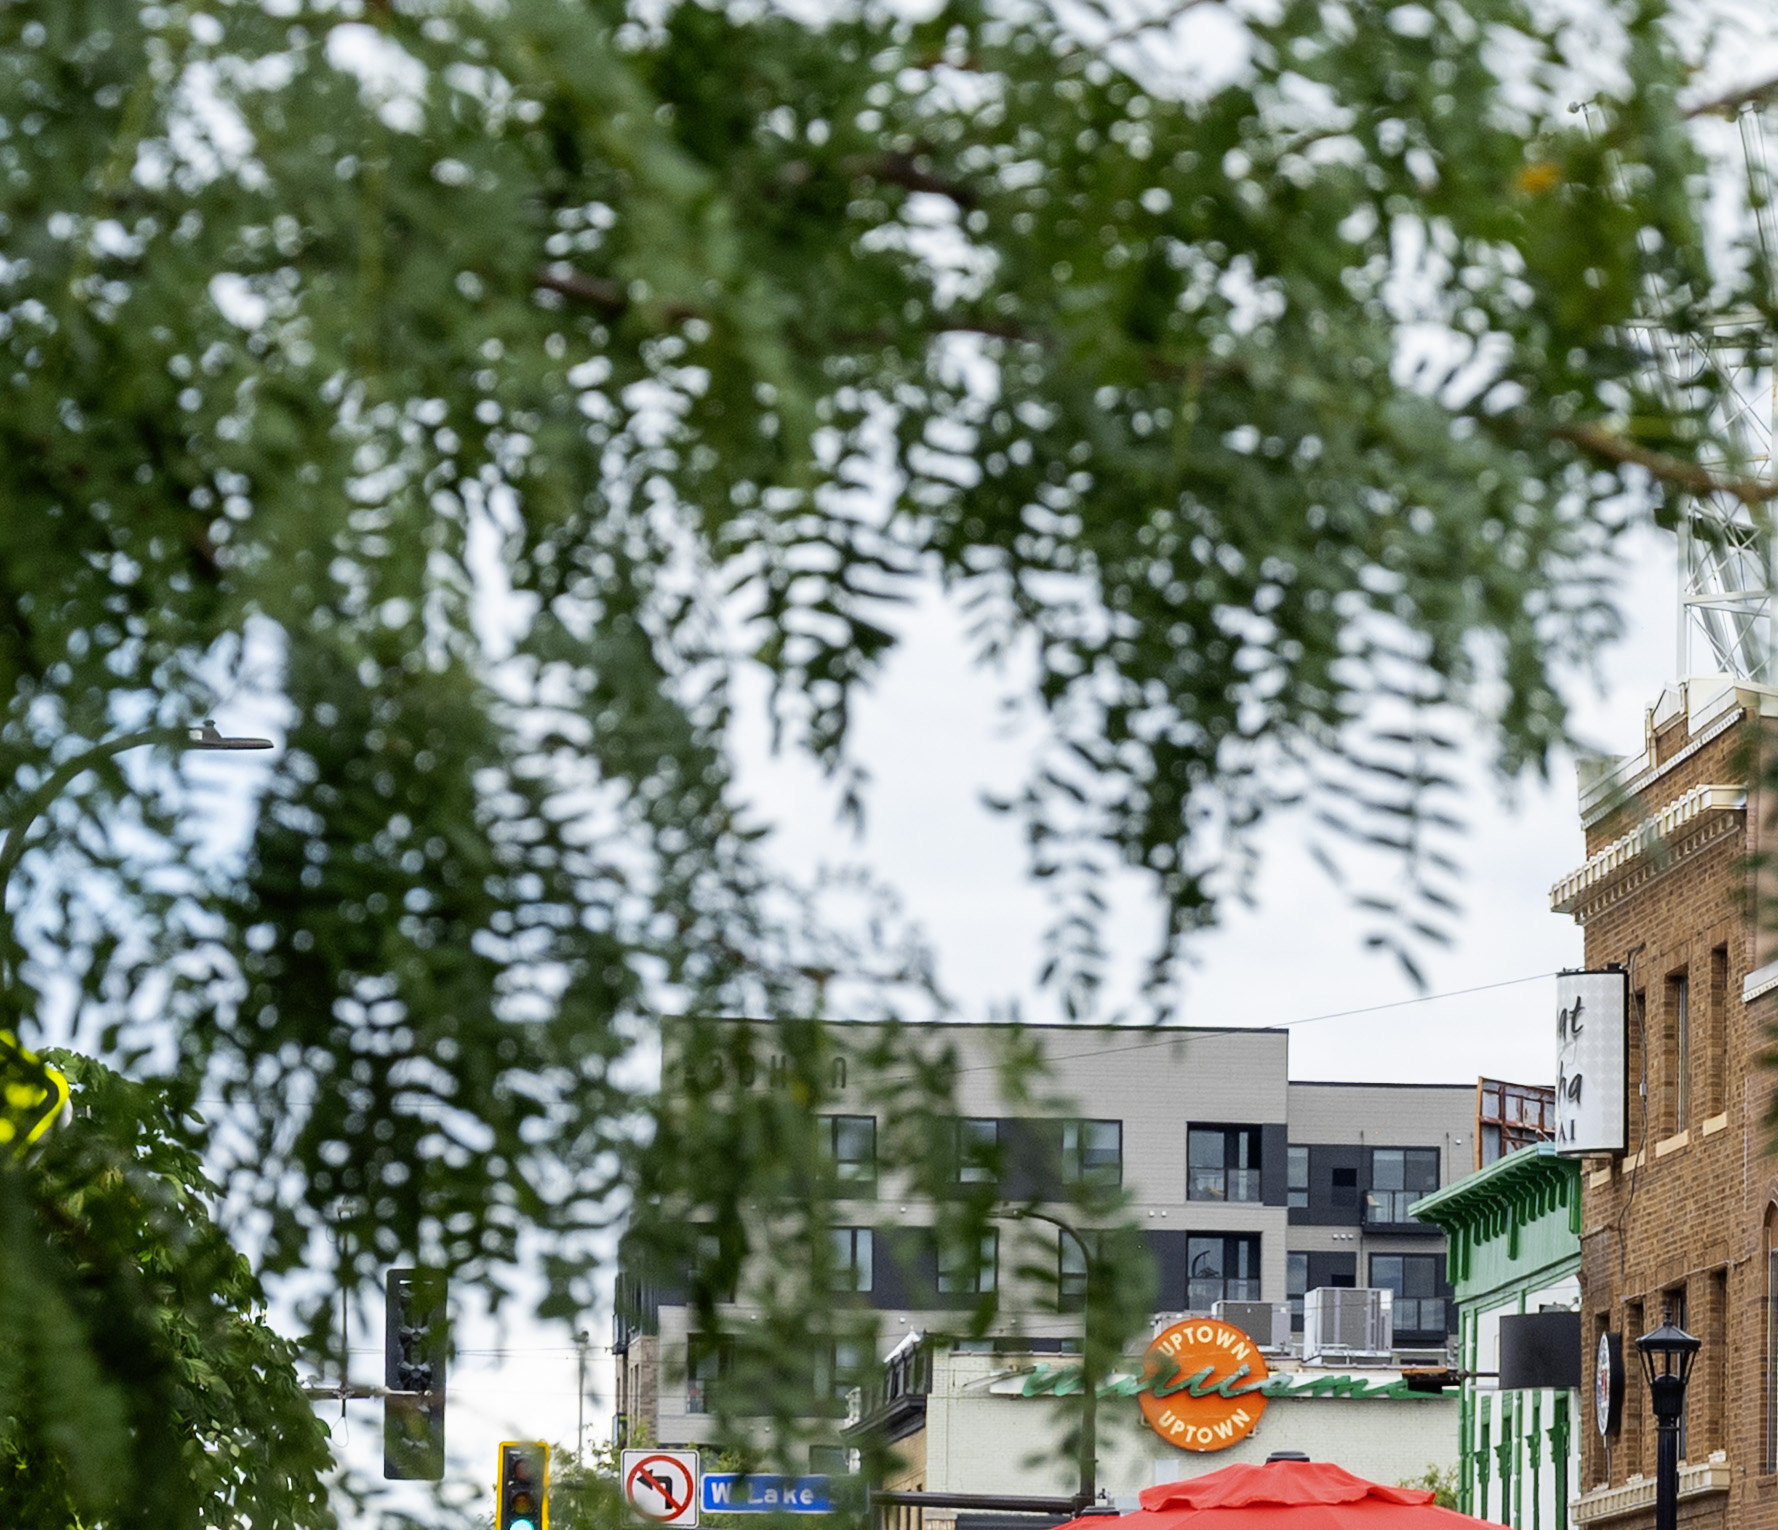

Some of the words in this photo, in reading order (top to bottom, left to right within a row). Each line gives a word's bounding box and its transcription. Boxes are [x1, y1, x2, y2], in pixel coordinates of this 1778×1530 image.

[1157, 1325, 1251, 1361] UPTOWN
[1157, 1408, 1251, 1444] UPTOWN
[711, 1482, 732, 1504] W
[747, 1482, 814, 1504] Lake
